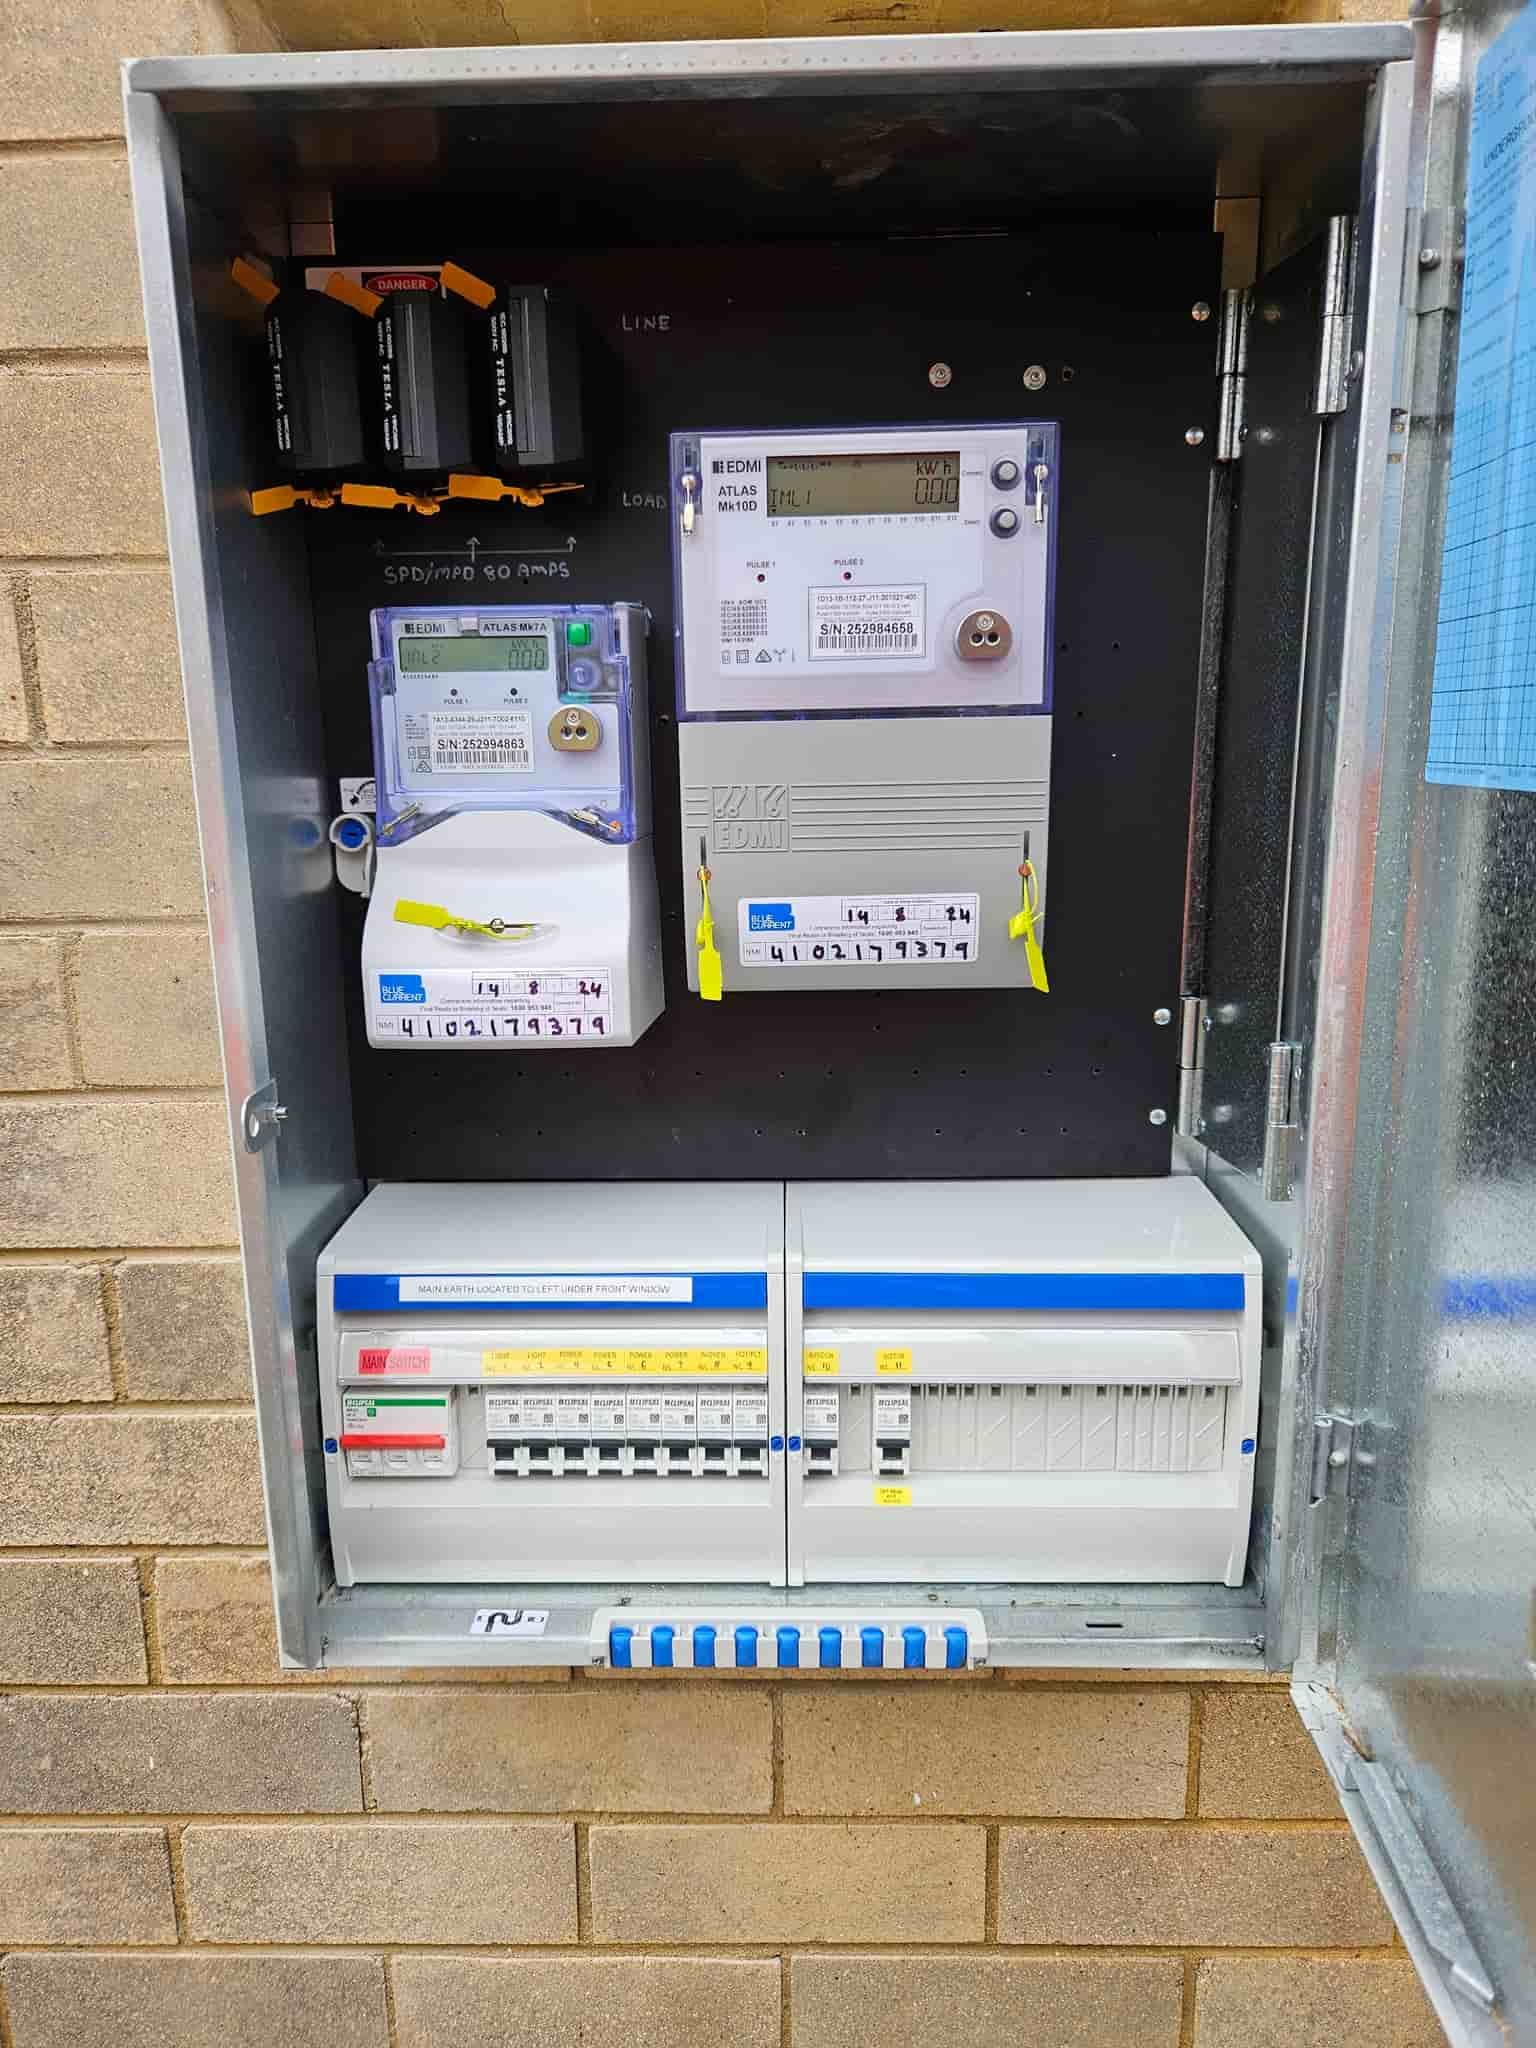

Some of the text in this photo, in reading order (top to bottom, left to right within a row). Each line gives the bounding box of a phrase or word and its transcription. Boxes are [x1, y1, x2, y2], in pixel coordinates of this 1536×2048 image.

[378, 278, 428, 290] DANGER
[622, 314, 671, 331] LINE
[272, 363, 284, 411] TESLA
[382, 363, 393, 411] TESLA
[496, 358, 507, 406] TESLA
[726, 460, 762, 474] EDMI
[718, 485, 758, 498] ATLAS
[622, 491, 668, 511] LOAD
[718, 501, 758, 513] Mk10D
[483, 565, 511, 582] 80
[416, 623, 446, 634] EDMI
[483, 623, 517, 633] ATLAS
[718, 822, 782, 849] EDMI
[848, 908, 869, 925] 14
[750, 921, 793, 930] CURRENT
[382, 986, 406, 994] BLUE
[478, 982, 499, 998] 14
[579, 980, 602, 999] 24
[419, 1285, 671, 1294] MAIN EARTH LOCATED TO LEFT UNDER FRONT WINDOW
[361, 1355, 427, 1369] MAIN SWITCH
